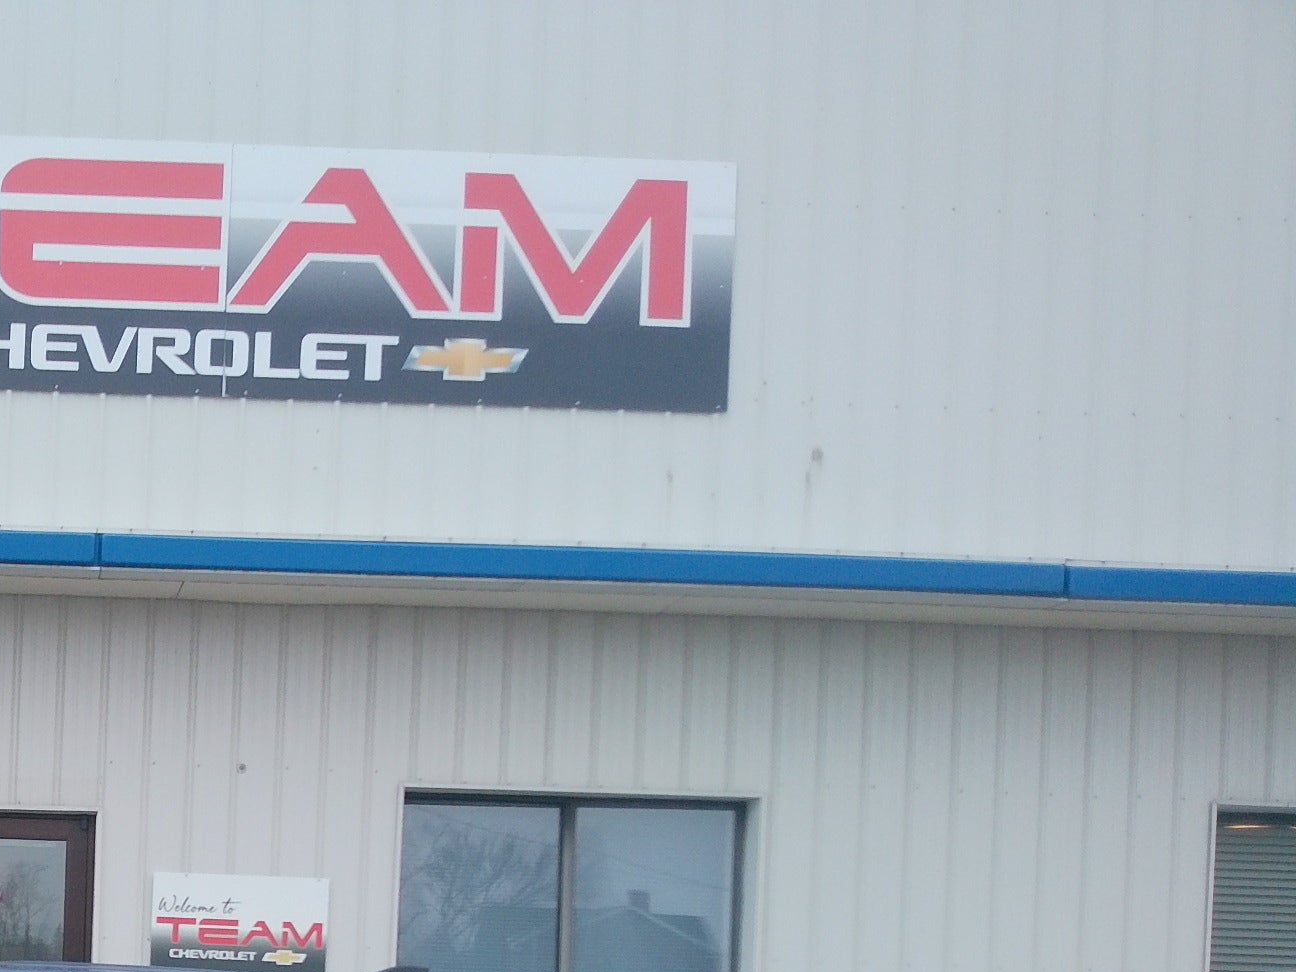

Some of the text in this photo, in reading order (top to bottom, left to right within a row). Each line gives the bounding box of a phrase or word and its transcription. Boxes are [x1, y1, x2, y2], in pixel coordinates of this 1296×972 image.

[158, 895, 241, 914] Welcome to
[156, 916, 323, 949] TEAM
[168, 948, 258, 961] CHEVROLET
